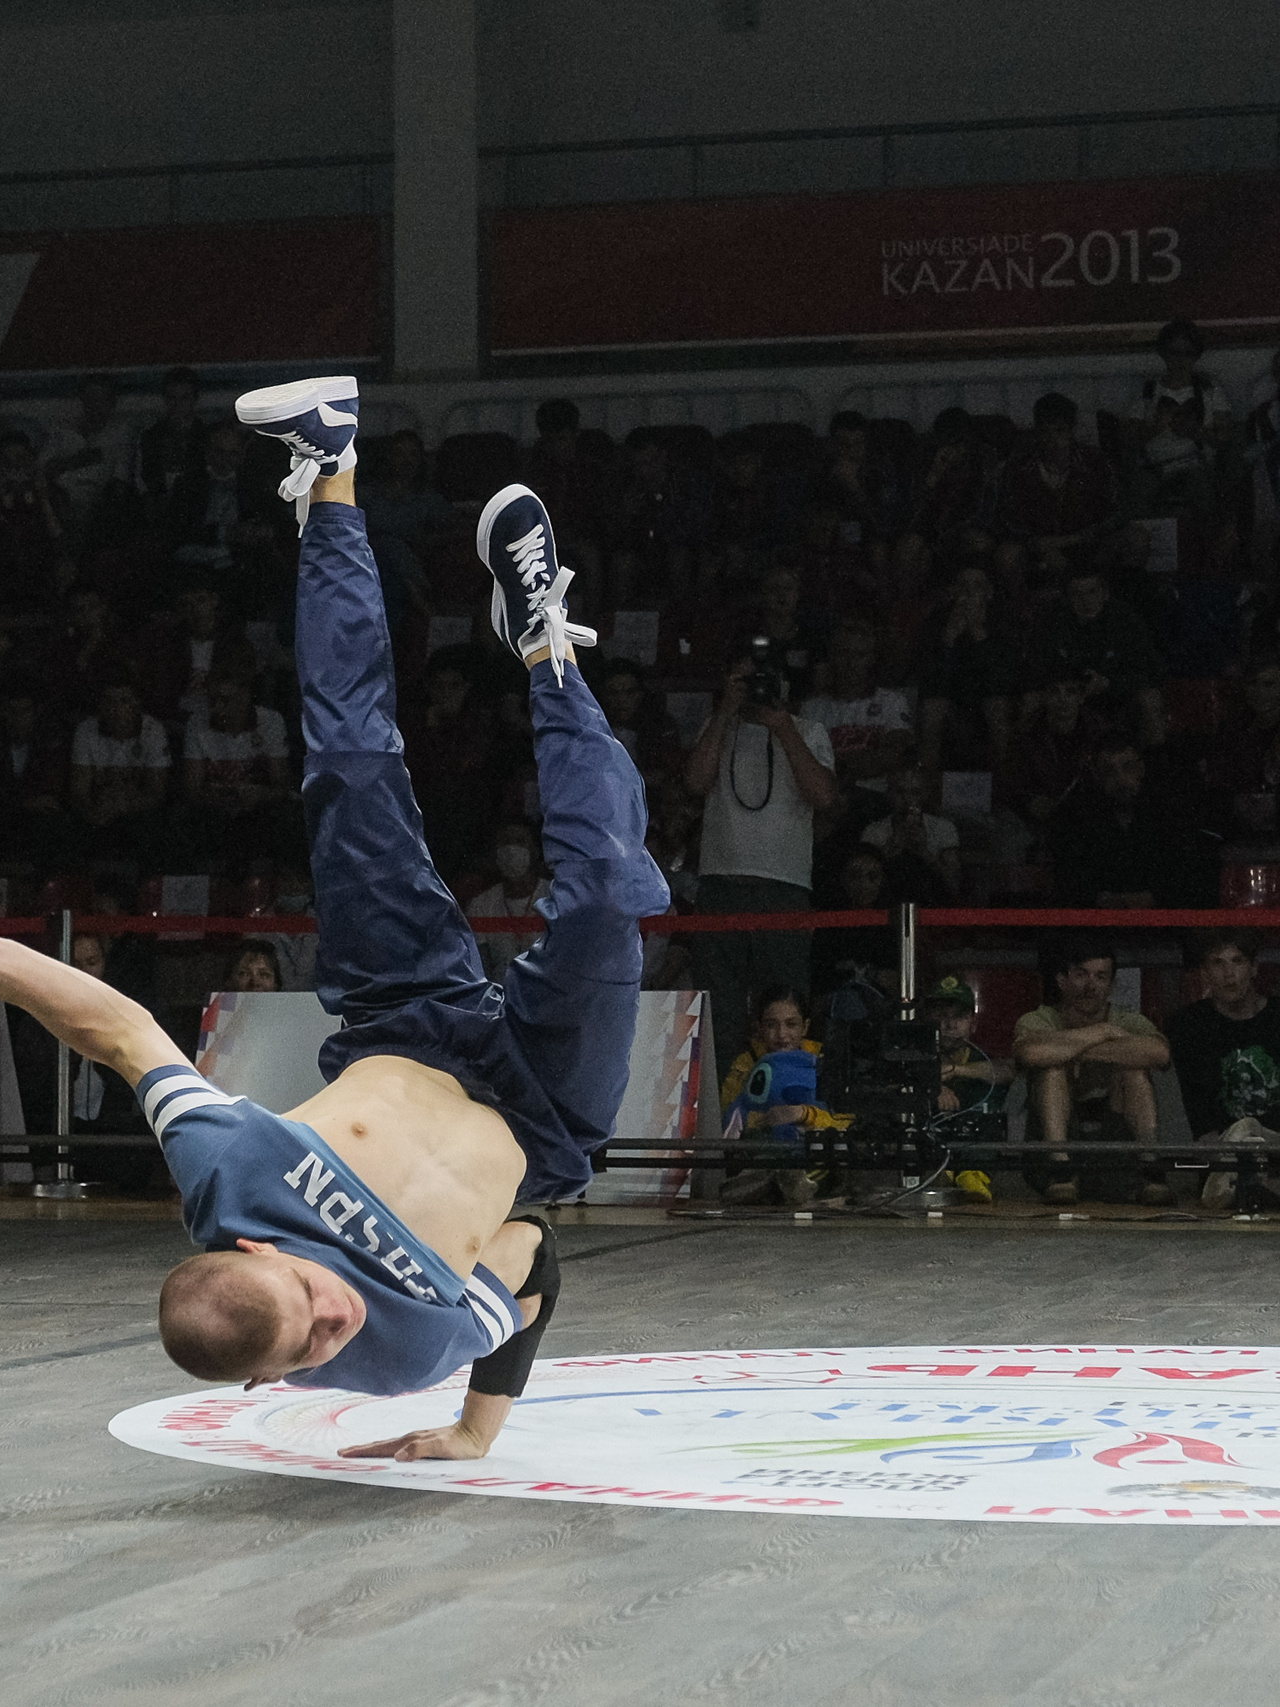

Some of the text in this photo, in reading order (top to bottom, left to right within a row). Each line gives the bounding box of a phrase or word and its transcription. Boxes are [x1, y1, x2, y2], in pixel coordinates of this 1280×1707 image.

[881, 234, 1035, 257] UNIVERSIADE
[882, 227, 1182, 295] KAZAN 2013
[938, 1347, 1261, 1356] ФИНАЛ
[867, 1364, 1280, 1380] АНЬ
[444, 1477, 844, 1507] ФИНАЛ
[983, 1505, 1280, 1520] НАЛ
